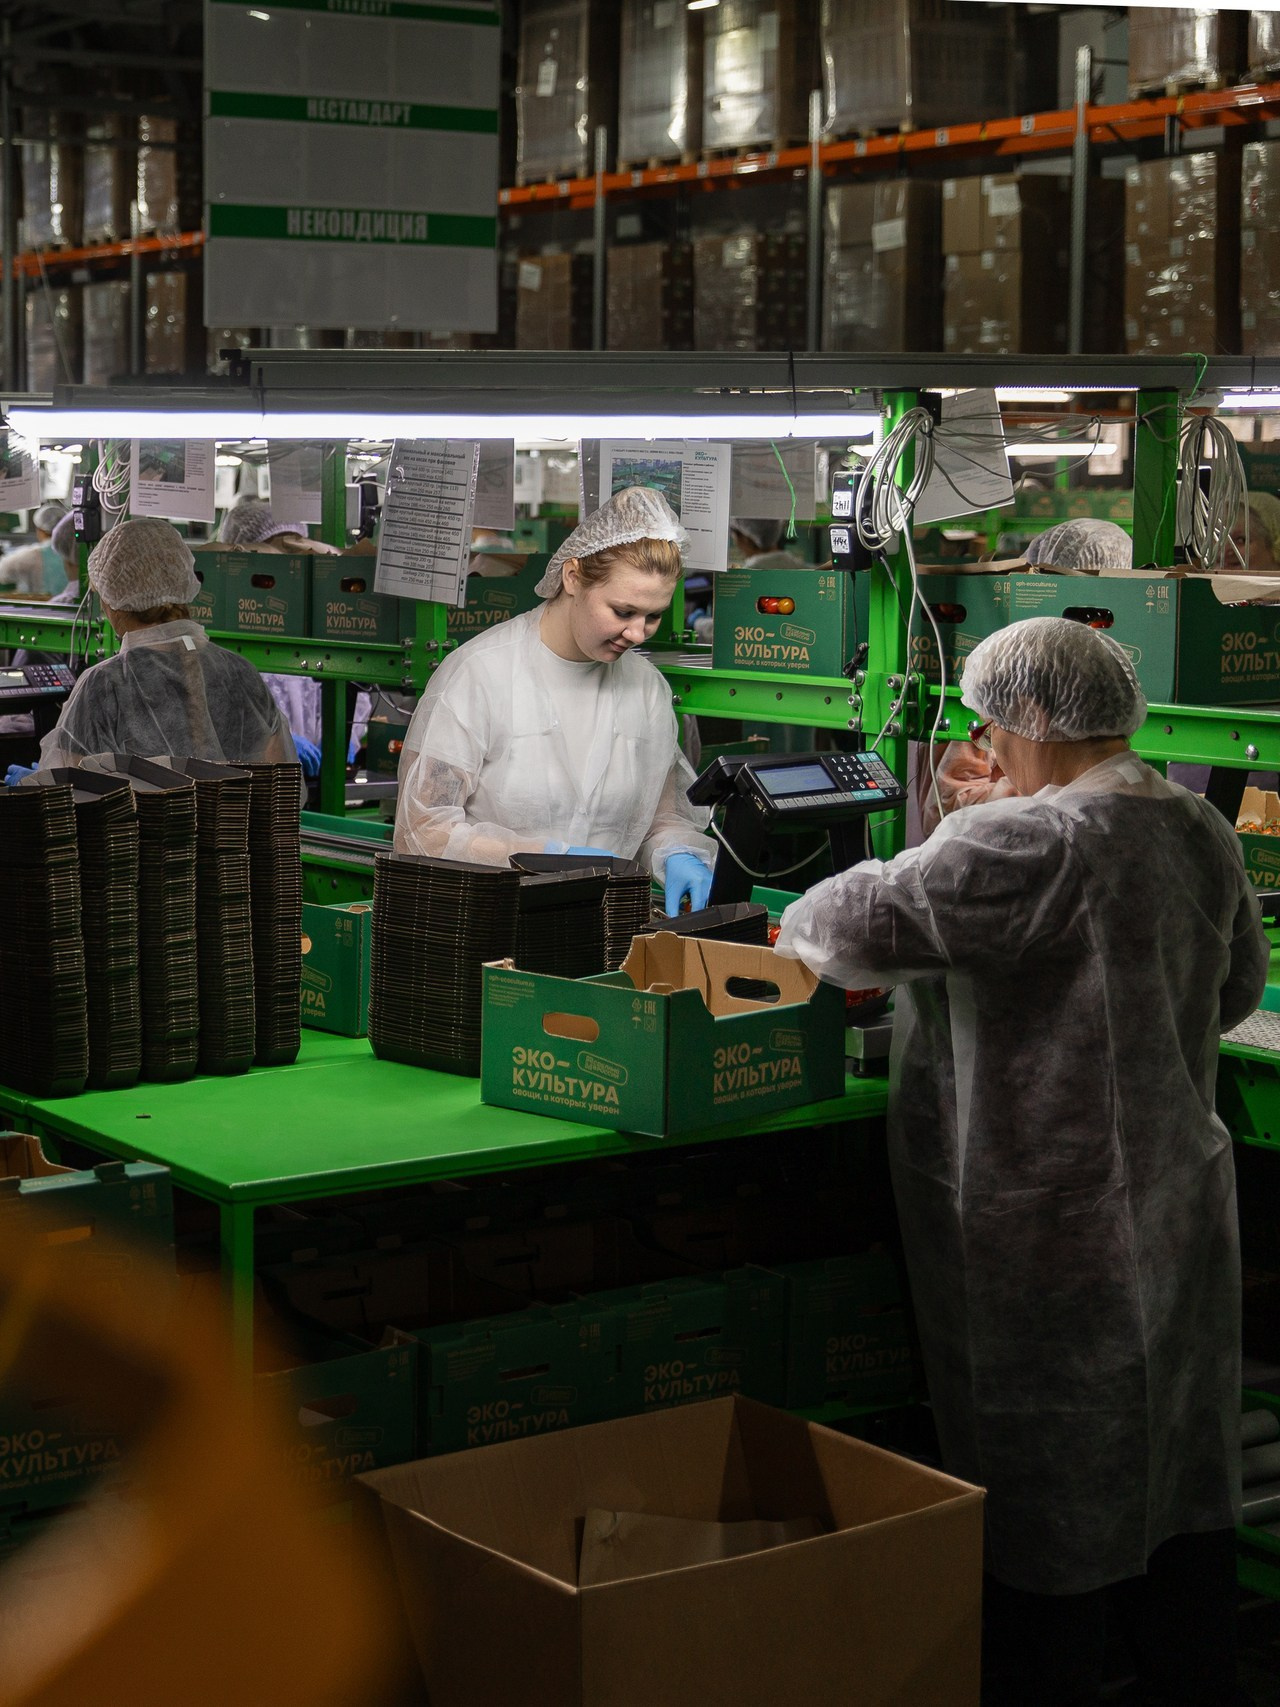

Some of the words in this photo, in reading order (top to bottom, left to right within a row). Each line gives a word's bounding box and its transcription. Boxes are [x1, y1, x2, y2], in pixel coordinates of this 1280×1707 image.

[306, 98, 413, 125] НЕСТАНДАРТ
[286, 208, 429, 242] НЕКОНДИЦИЯ
[239, 599, 263, 611] ЭКО-
[326, 602, 353, 615] ЭКО-
[238, 611, 285, 626] КУЛЬТУРА
[326, 615, 377, 630] КУЛЬТУРА
[448, 609, 511, 625] УЛЬТУРА
[734, 626, 775, 642] ЭКО-
[1221, 632, 1268, 651] ЭКО-
[734, 643, 809, 661] КУЛЬТУРА
[1221, 651, 1280, 673] КУЛЬТУ
[512, 1046, 569, 1070] ЭКО-
[713, 1042, 763, 1069] ЭКО-
[512, 1067, 619, 1105] КУЛЬТУРА
[713, 1056, 801, 1093] КУЛЬТУРА
[513, 1087, 542, 1101] овощи,
[551, 1095, 586, 1109] которых
[588, 1102, 619, 1115] уверен
[825, 1333, 880, 1352] ЭКО-
[643, 1359, 699, 1382] ЭКО-
[825, 1345, 912, 1374] КУЛЬТУР
[643, 1368, 740, 1402] КУЛЬТУРА
[467, 1399, 524, 1425] ЭКО-
[467, 1407, 569, 1446] КУЛЬТУРА
